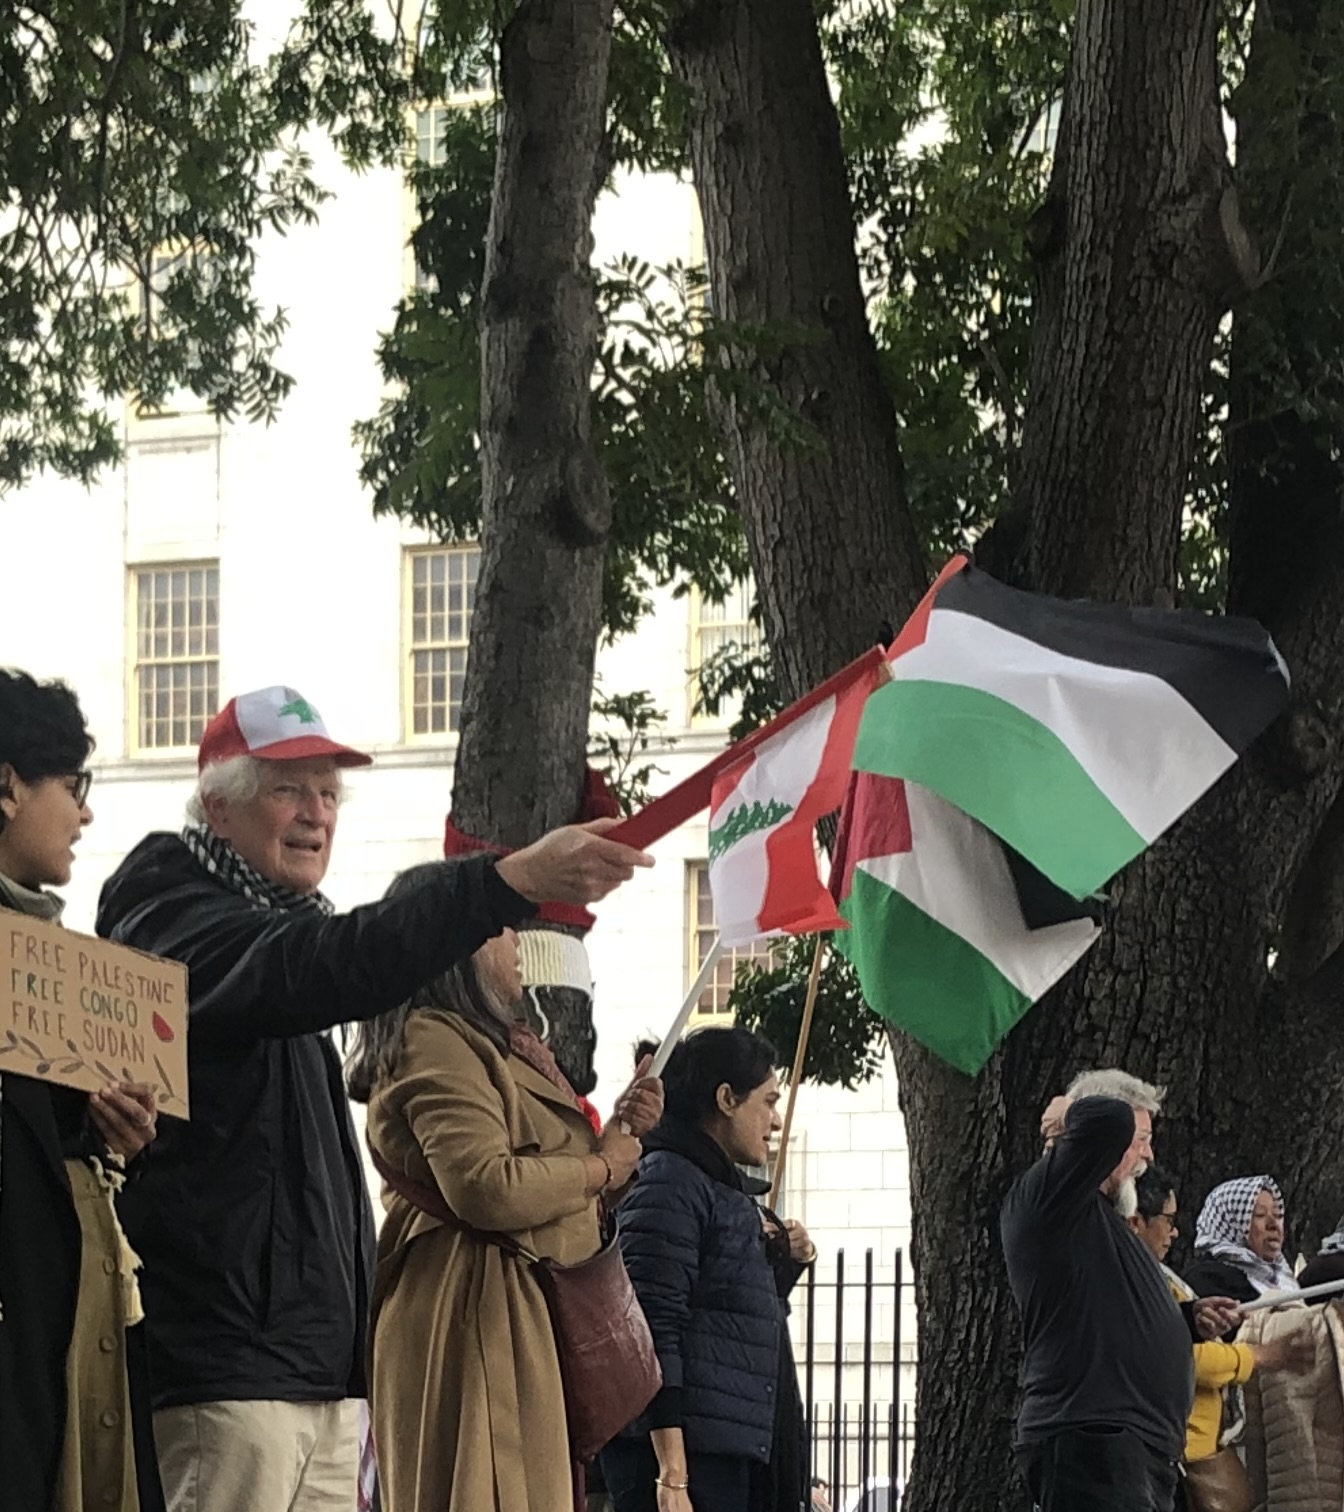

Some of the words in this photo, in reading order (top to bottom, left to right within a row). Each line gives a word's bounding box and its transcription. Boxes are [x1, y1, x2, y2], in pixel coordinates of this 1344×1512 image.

[10, 931, 66, 973] FREE
[79, 951, 175, 1004] PALESTINE
[11, 968, 64, 1004] FREE
[80, 987, 138, 1028] CONGO
[12, 1002, 66, 1040] FREE
[83, 1019, 145, 1064] SUDAN
